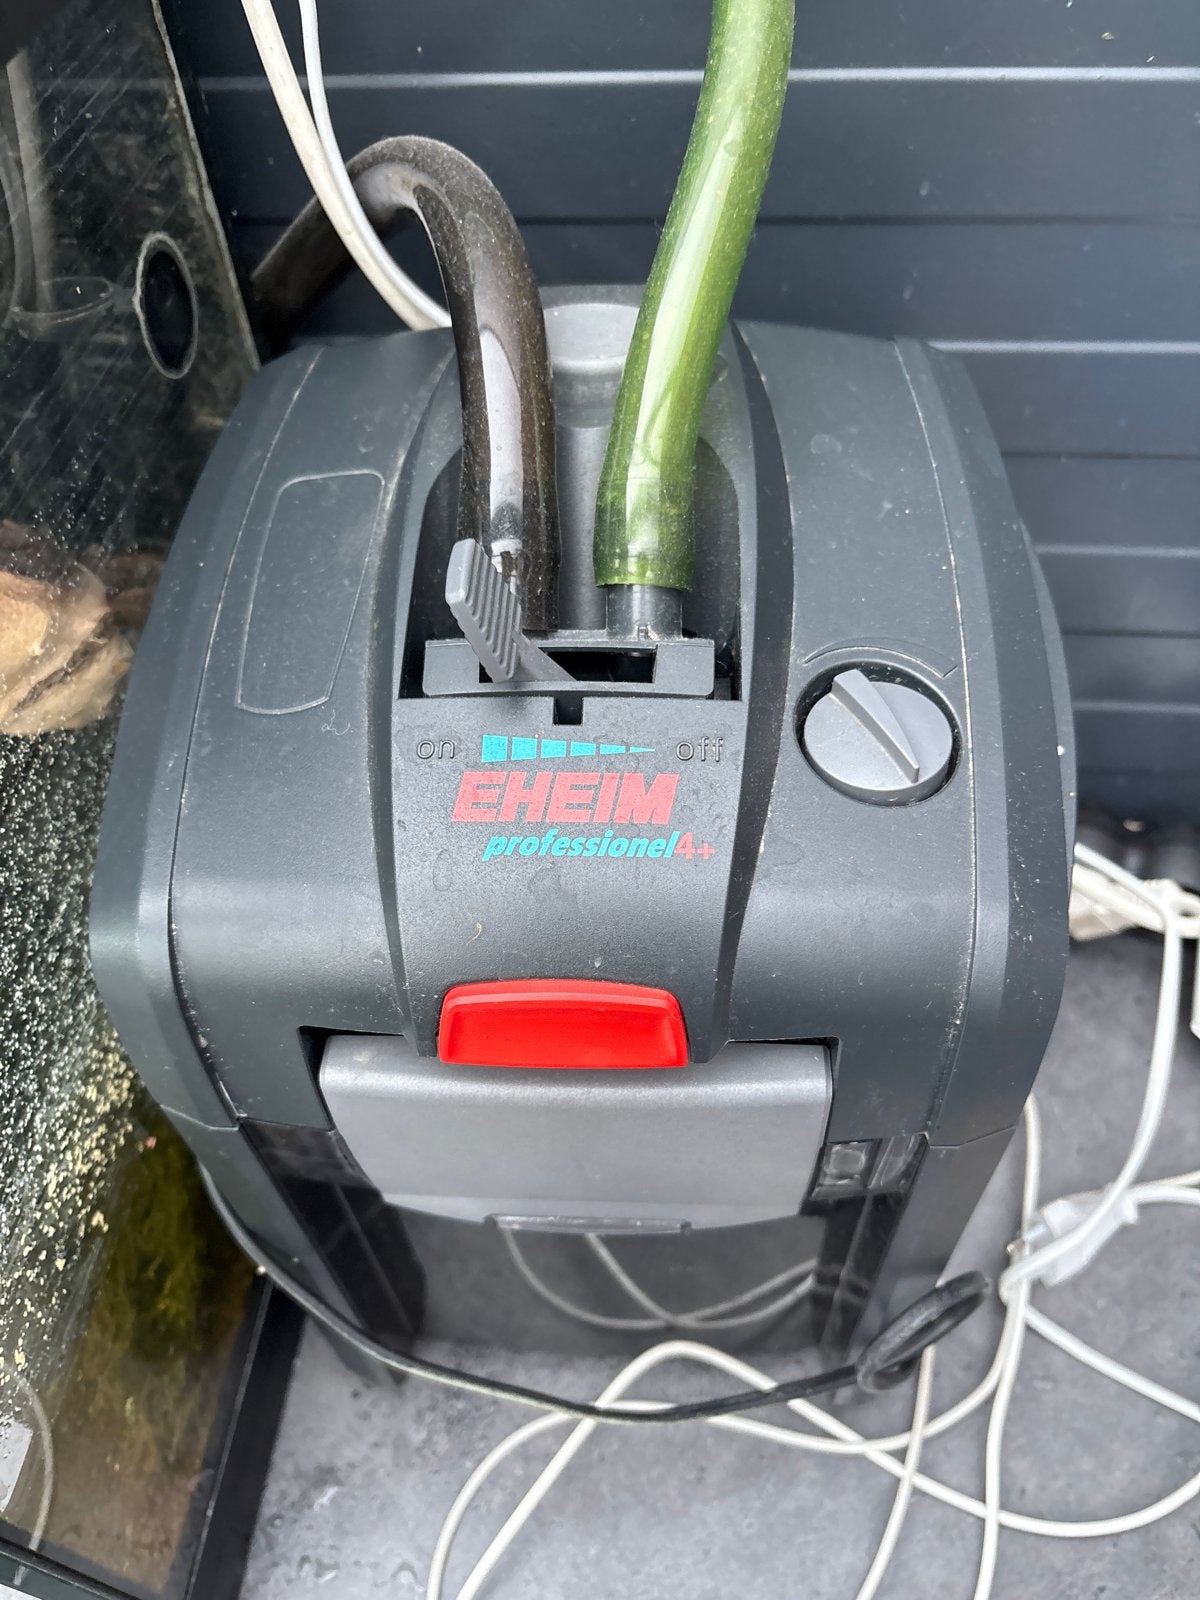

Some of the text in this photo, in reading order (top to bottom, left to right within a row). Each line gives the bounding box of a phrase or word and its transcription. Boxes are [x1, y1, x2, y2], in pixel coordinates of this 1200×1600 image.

[416, 739, 456, 759] on
[675, 736, 724, 762] off
[451, 770, 680, 825] EHEIM
